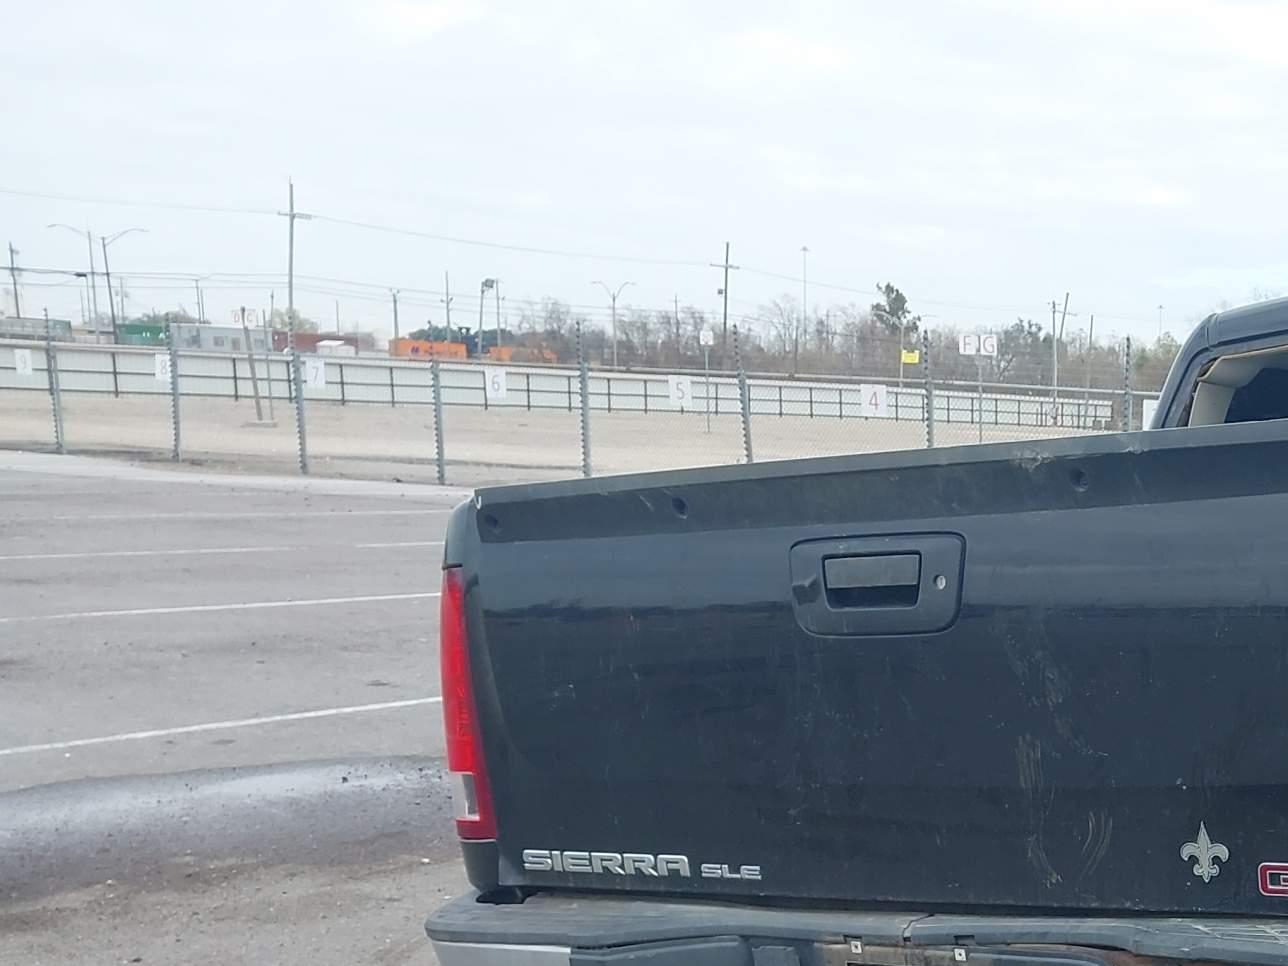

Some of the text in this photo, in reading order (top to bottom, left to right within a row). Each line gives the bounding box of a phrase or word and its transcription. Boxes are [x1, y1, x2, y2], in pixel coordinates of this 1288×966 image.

[962, 336, 972, 354] F
[983, 336, 996, 354] G
[160, 359, 168, 376] 8
[312, 365, 321, 382] 7
[491, 374, 501, 392] 6
[675, 383, 685, 400] 5
[868, 391, 880, 411] 4
[522, 848, 762, 880] SIERRA SLE
